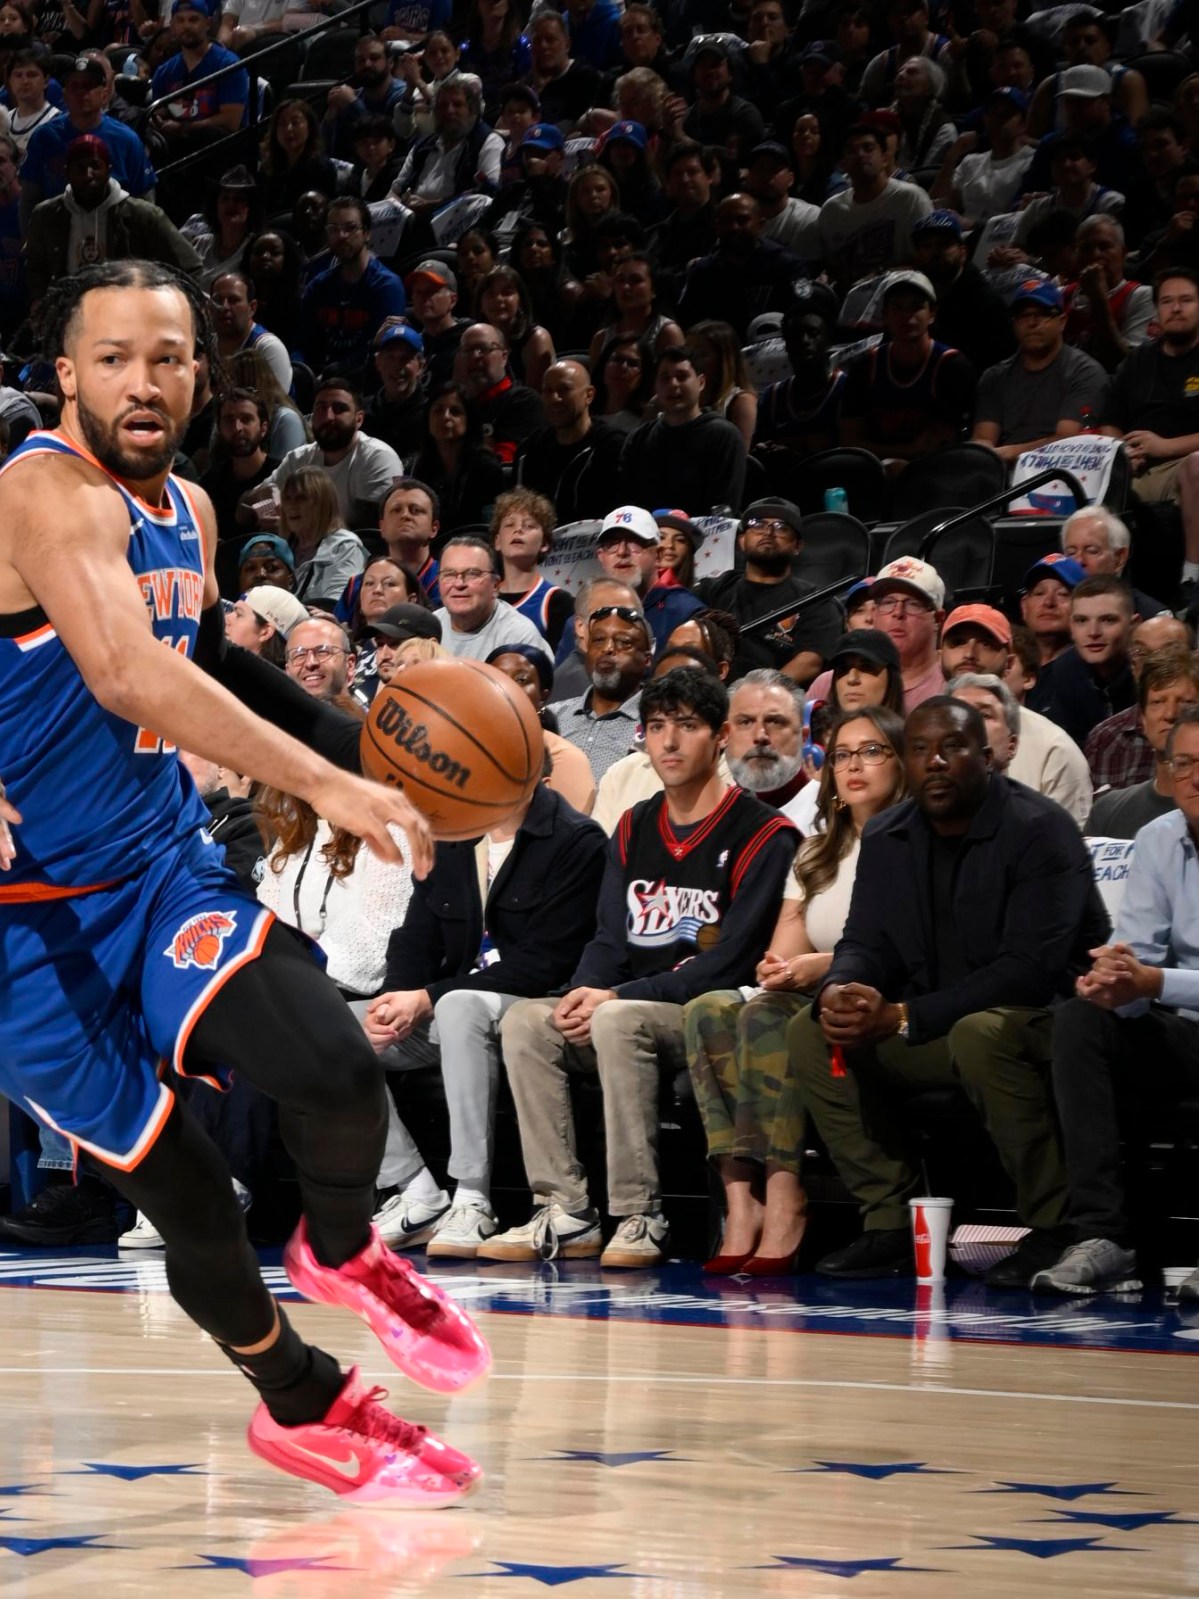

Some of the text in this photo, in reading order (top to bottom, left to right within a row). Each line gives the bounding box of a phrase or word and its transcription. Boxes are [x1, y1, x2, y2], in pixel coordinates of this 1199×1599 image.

[615, 512, 633, 524] 76
[376, 696, 472, 791] Wilson
[1103, 845, 1126, 857] FOR
[626, 879, 721, 936] SIXERS
[175, 914, 234, 965] KNICKS
